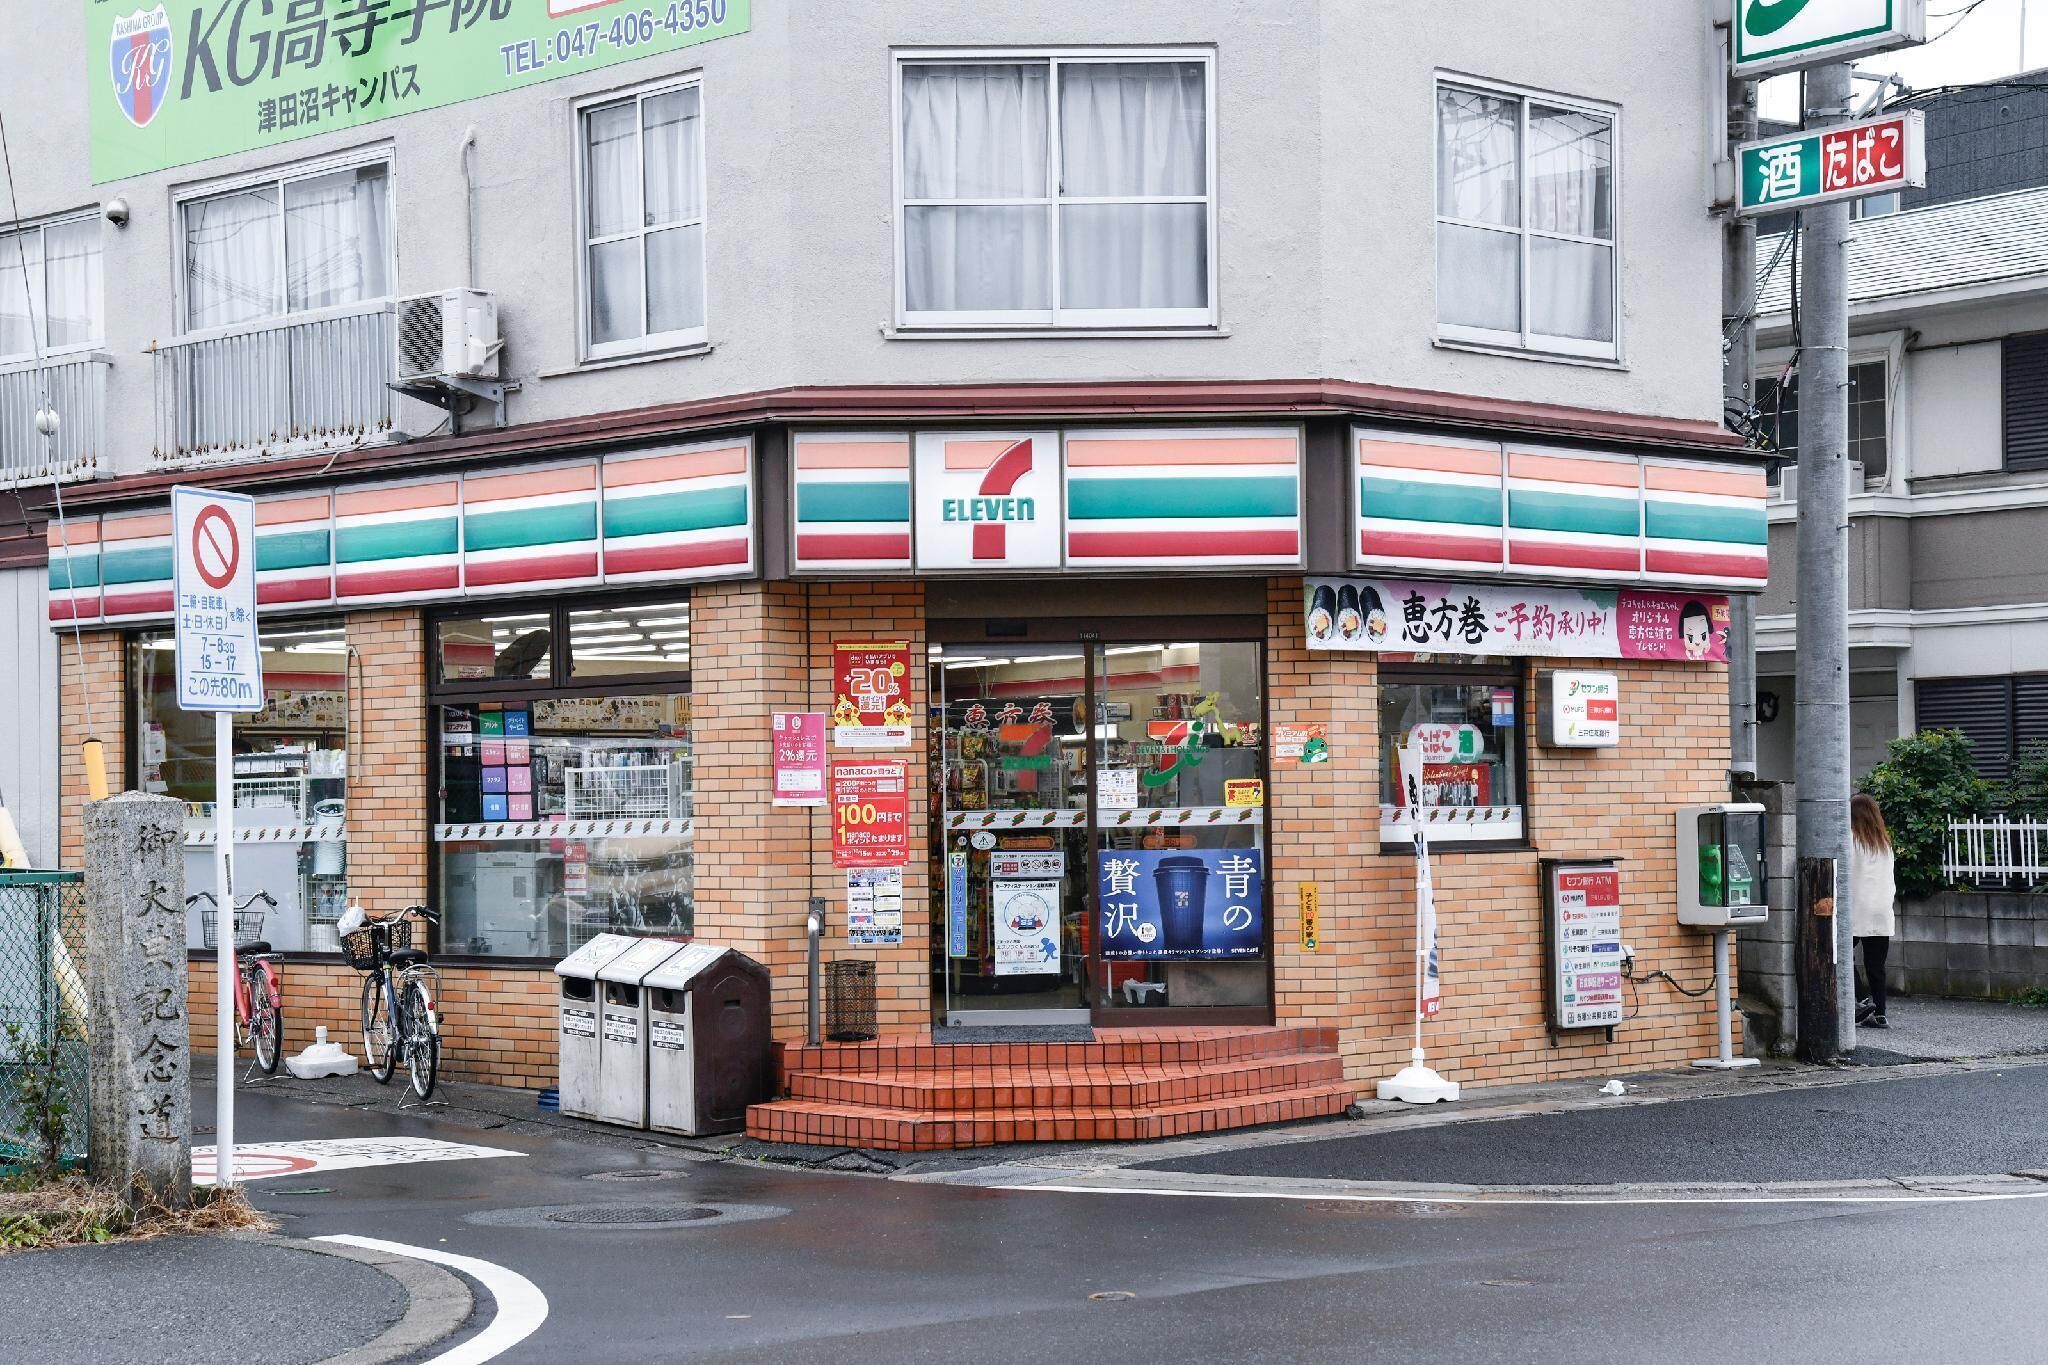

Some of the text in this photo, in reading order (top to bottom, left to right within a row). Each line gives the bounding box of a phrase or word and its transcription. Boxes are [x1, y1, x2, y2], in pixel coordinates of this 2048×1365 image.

[116, 12, 164, 36] KASHIMA GROUP
[257, 64, 421, 134] 津田沼キャンパス
[1758, 127, 1901, 202] 酒 たばこ
[183, 615, 223, 630] 土・日・休日
[229, 608, 251, 623] を除く
[1402, 590, 1490, 645] 恵方巻
[1632, 611, 1670, 623] オリジナル
[1628, 625, 1673, 640] 恵方位磁石
[1636, 641, 1666, 652] プレゼント!
[188, 677, 253, 699] この先80m
[1581, 685, 1609, 694] セブン銀行
[860, 701, 885, 711] 還元!
[779, 749, 818, 762] 2%還元
[871, 834, 903, 843] たまります
[1567, 876, 1612, 886] セブン銀行 ATM
[1103, 858, 1141, 939] 贅沢
[1216, 854, 1257, 931] 青の
